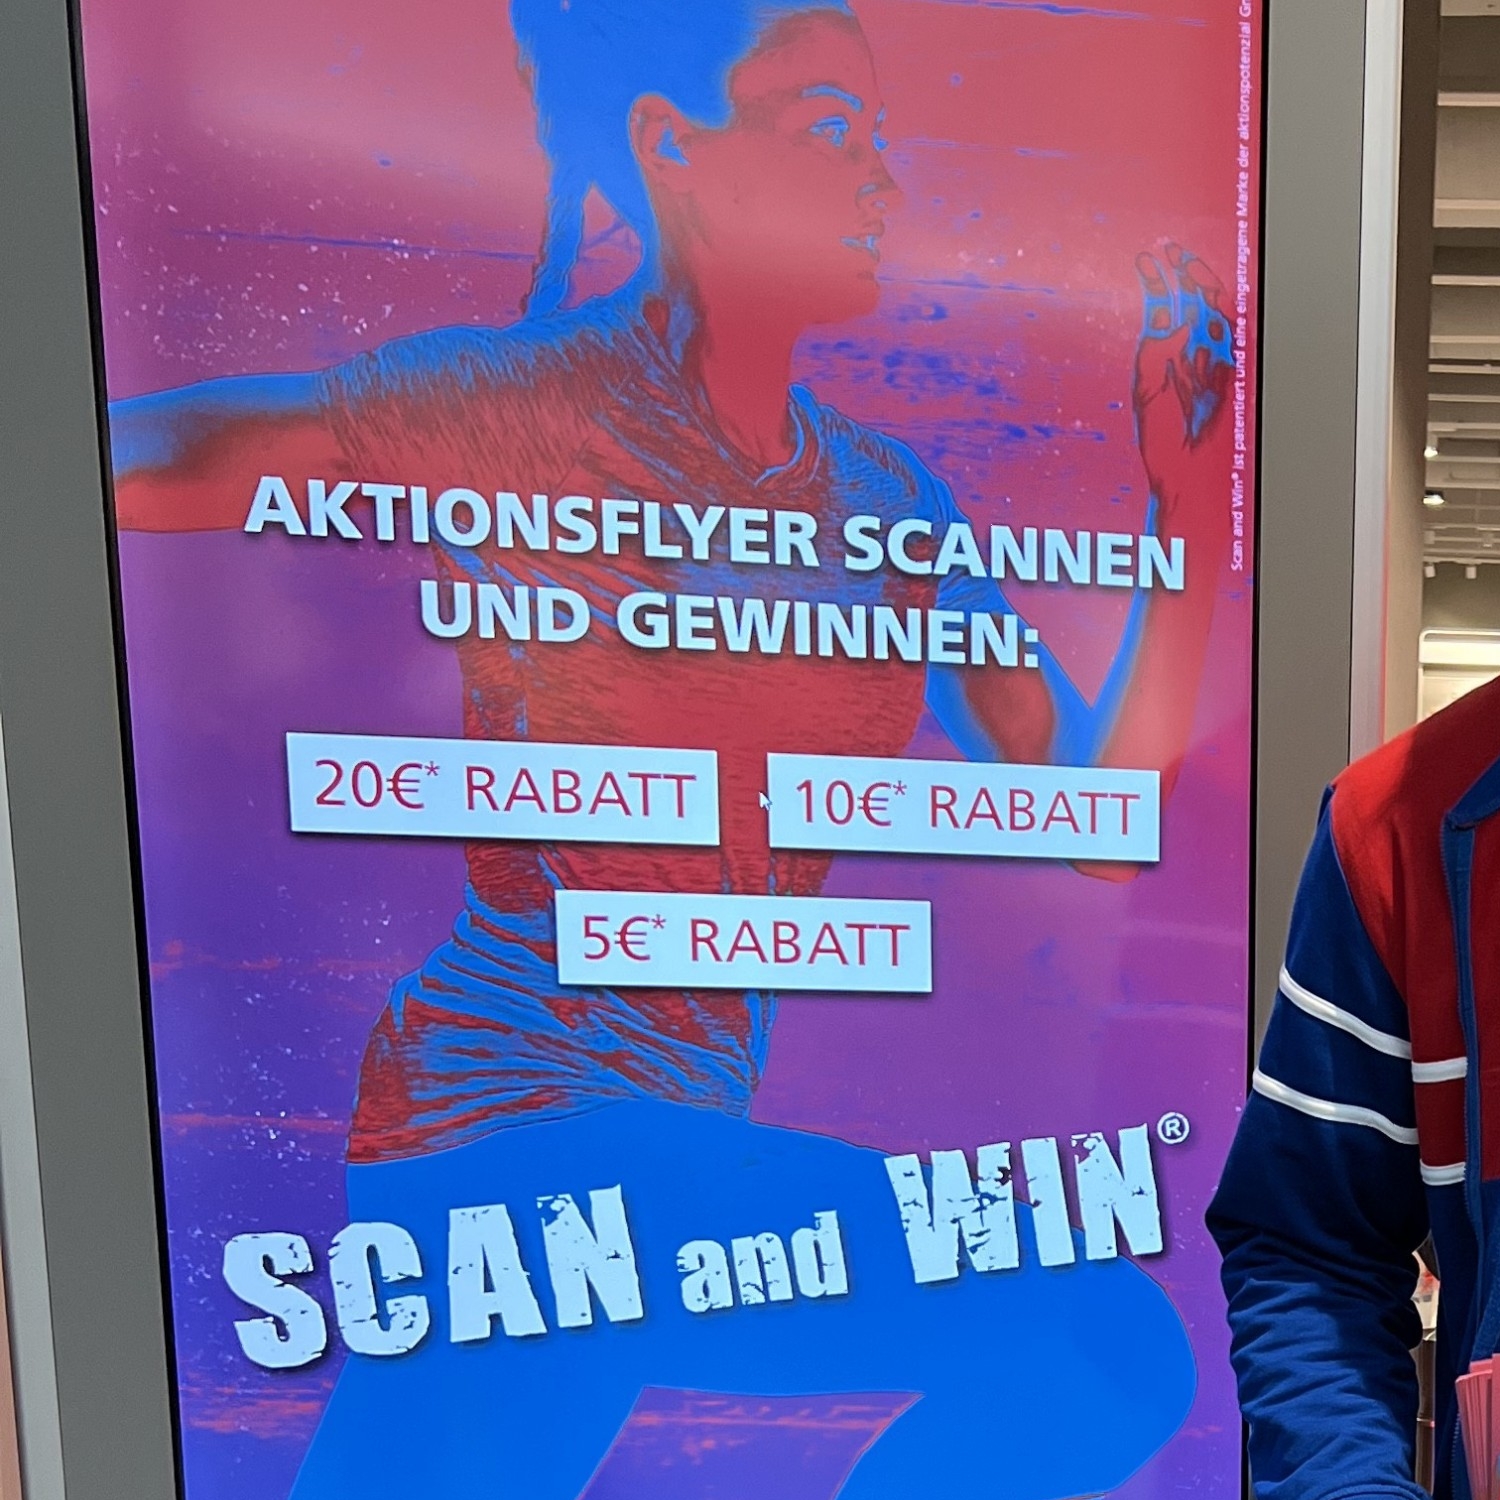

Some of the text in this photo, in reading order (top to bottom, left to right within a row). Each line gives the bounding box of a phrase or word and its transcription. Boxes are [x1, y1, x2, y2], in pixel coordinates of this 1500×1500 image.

[1236, 144, 1249, 167] der
[1236, 172, 1248, 216] Marke
[1234, 220, 1250, 314] eingetragene
[1234, 318, 1247, 347] eine
[1234, 350, 1246, 378] und
[1234, 380, 1247, 451] patentiert
[1234, 453, 1245, 470] ist
[243, 475, 1186, 591] AKTIONSFLYER SCANNEN
[1233, 512, 1243, 537] and
[1231, 541, 1243, 571] Scan
[419, 579, 1040, 667] UND GEWINNEN:
[465, 765, 698, 819] RABATT
[929, 785, 1140, 836] RABATT
[691, 918, 911, 968] RABATT
[222, 1184, 646, 1370] SCAN
[676, 1210, 850, 1314] and
